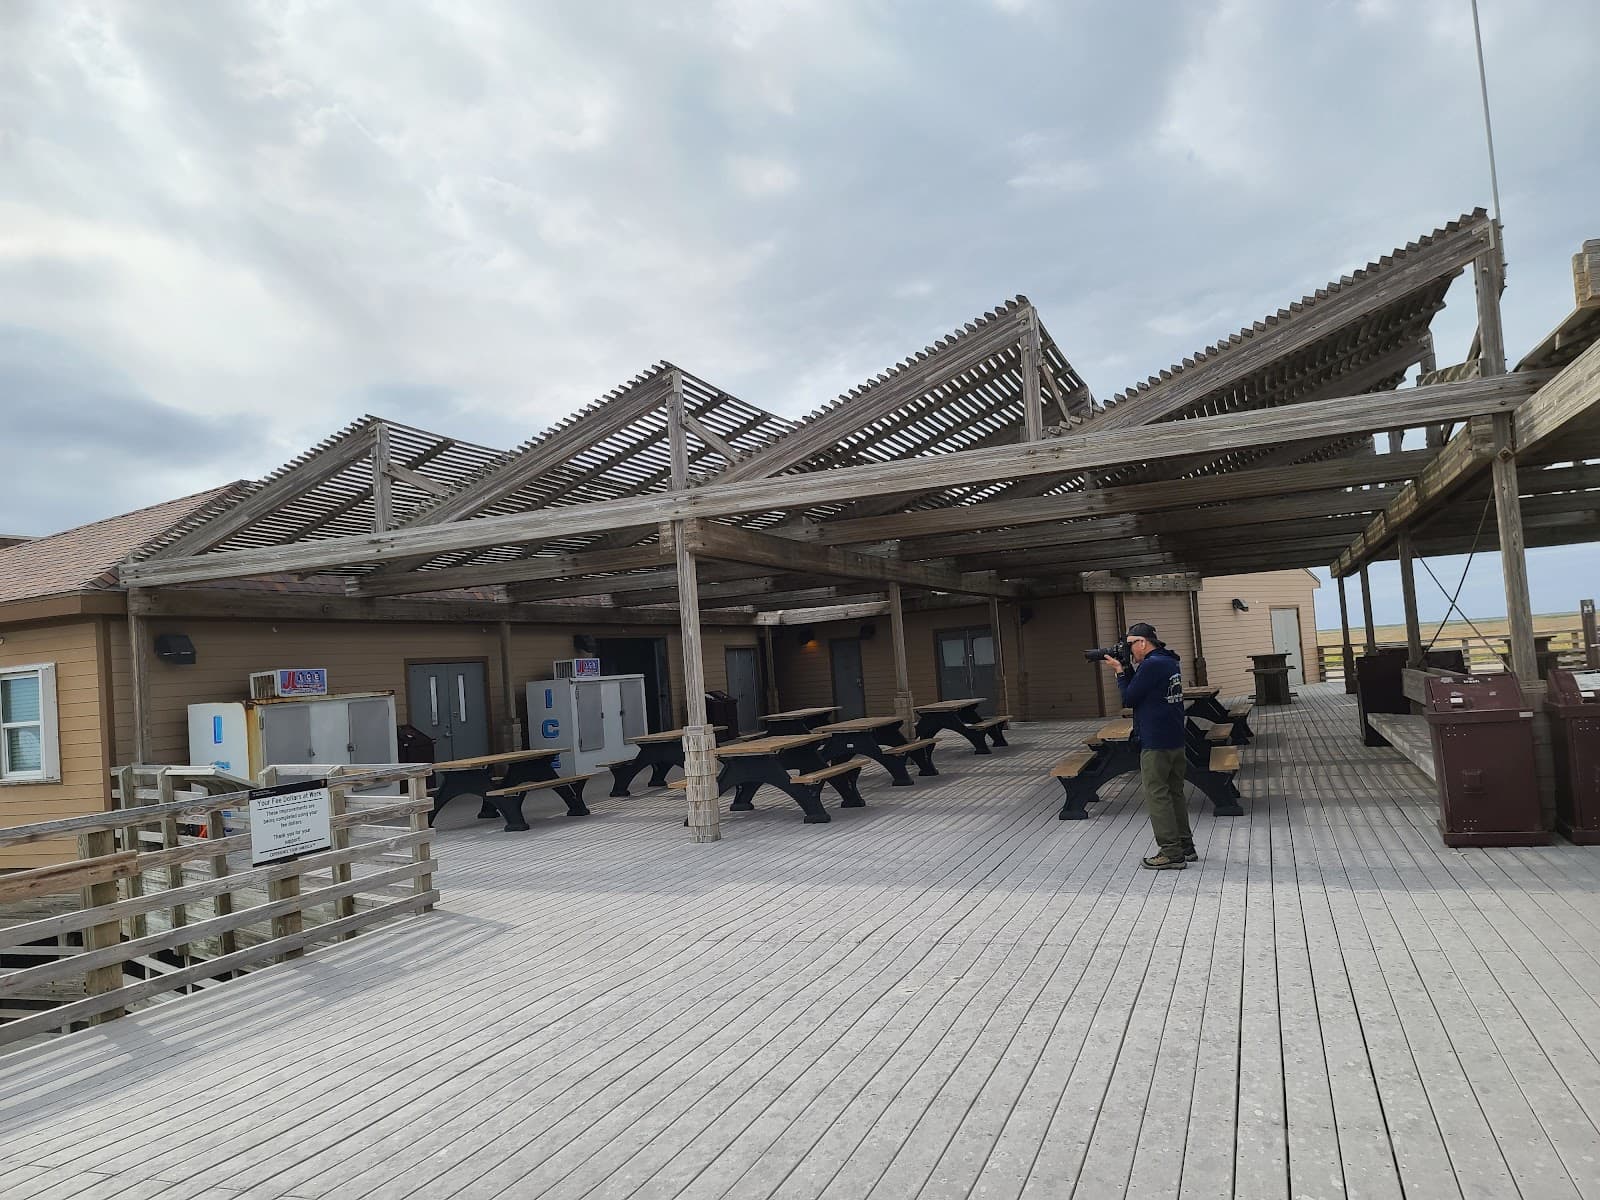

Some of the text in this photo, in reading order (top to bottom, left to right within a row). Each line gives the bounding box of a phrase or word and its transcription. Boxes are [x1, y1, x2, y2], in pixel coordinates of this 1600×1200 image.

[298, 671, 321, 681] ICE
[257, 799, 270, 807] Your
[283, 794, 301, 802] Dollars
[279, 805, 308, 814] improvements
[276, 813, 297, 821] completed
